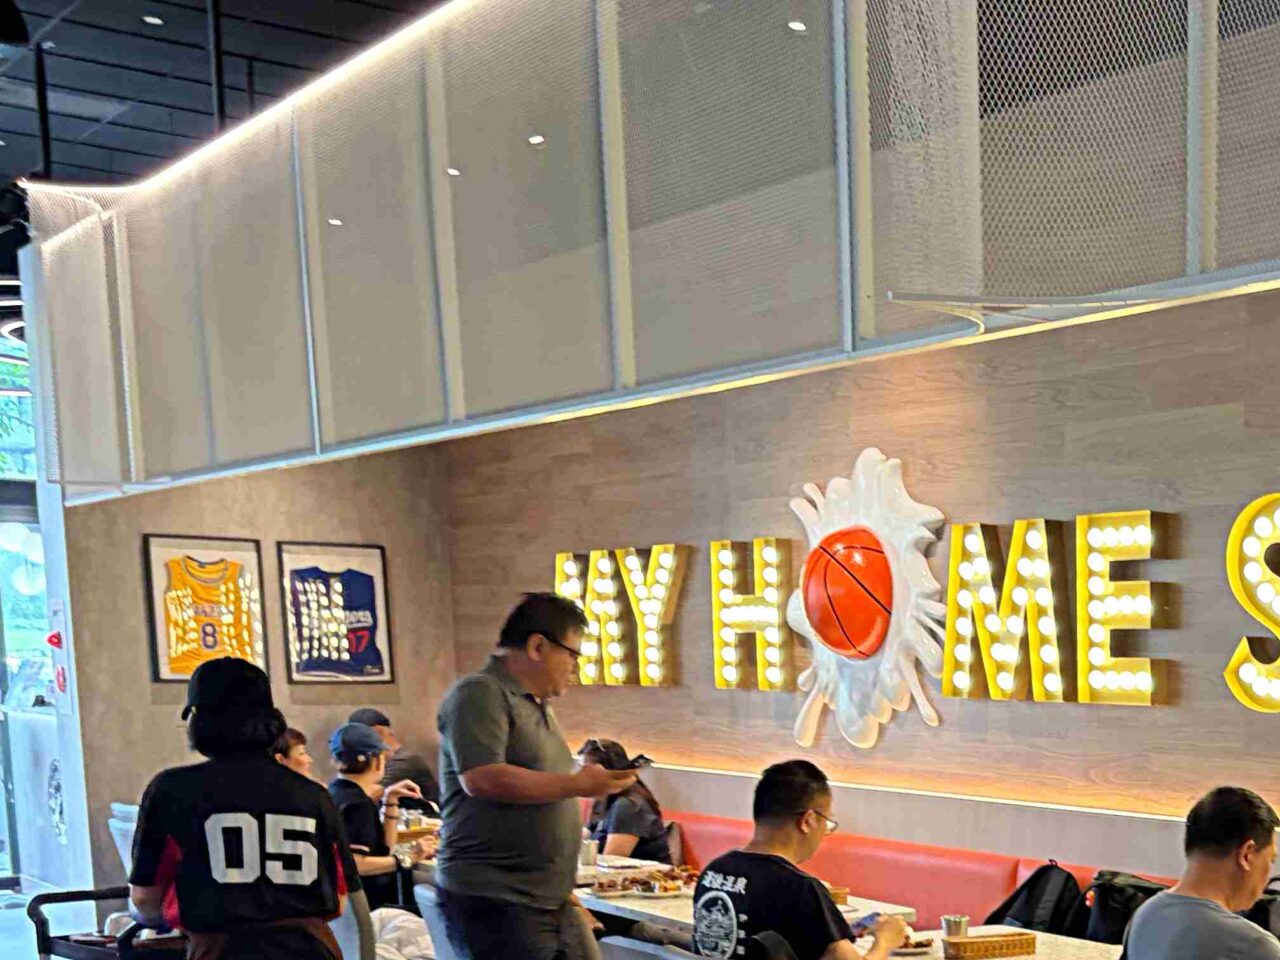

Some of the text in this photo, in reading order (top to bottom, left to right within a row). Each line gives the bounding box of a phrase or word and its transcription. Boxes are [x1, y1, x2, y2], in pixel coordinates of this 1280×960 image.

[201, 622, 218, 650] 8
[554, 543, 678, 687] MY
[204, 812, 318, 886] 05
